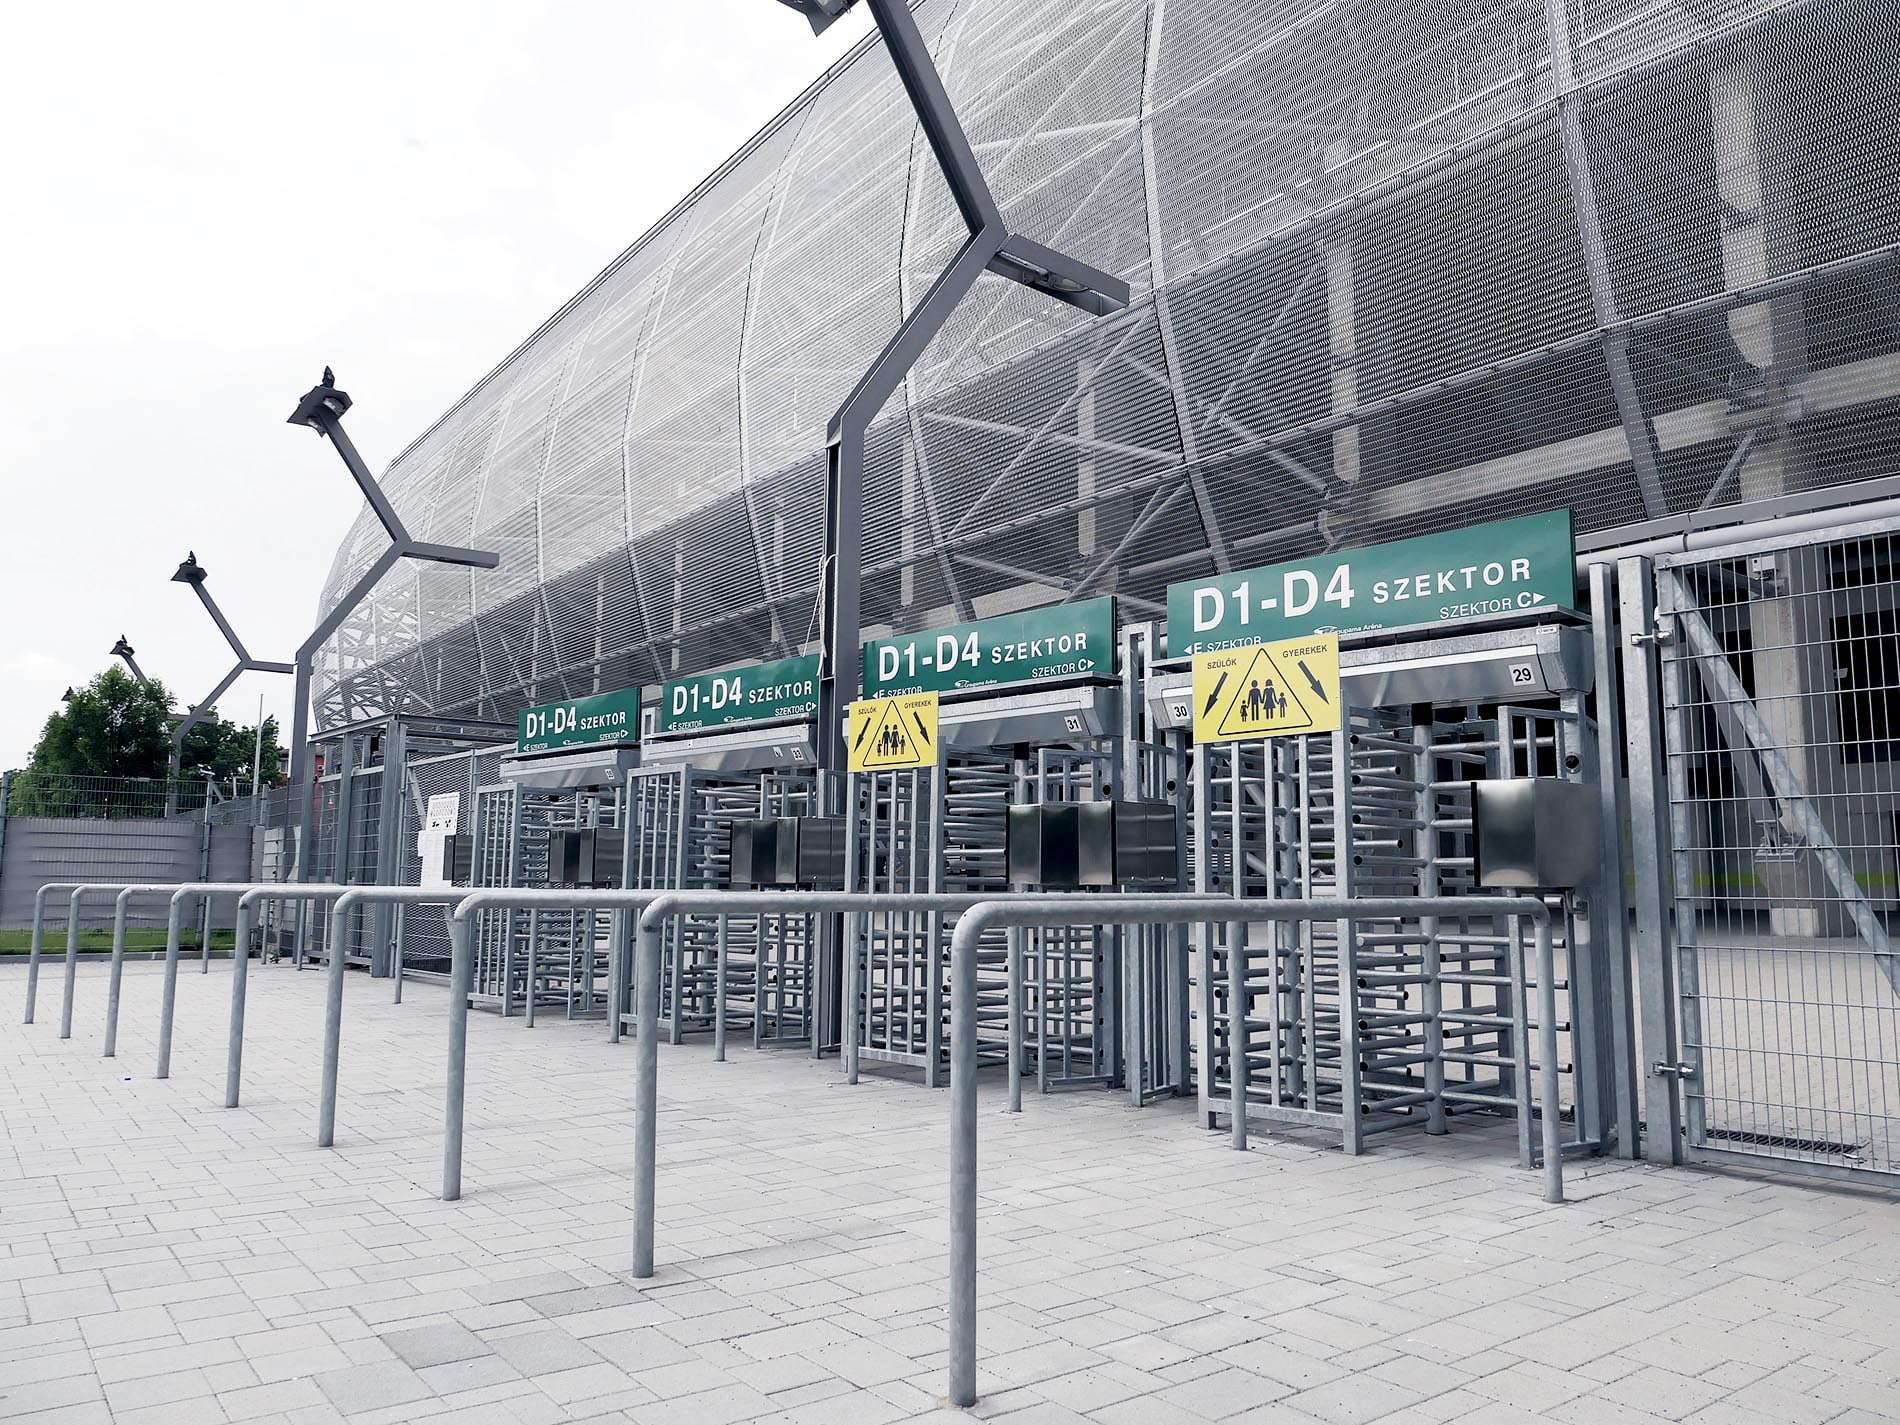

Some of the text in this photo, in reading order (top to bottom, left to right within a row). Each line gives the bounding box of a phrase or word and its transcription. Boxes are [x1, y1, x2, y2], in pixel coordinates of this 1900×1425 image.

[1193, 558, 1531, 633] D1-D4 SZEKTOR
[1440, 591, 1532, 619] SZEKTOR C
[879, 631, 1087, 682] D1-D4 SZEKTOR
[1282, 644, 1328, 658] GYEREKEK
[1031, 658, 1087, 678] SZEKTOR C
[1512, 667, 1532, 682] 29
[672, 676, 812, 716] D1-D4 SZEKTOR
[775, 704, 804, 716] SZEKTOR
[1174, 706, 1188, 718] 30
[526, 706, 626, 739] D1-D4 SZEKTOR
[678, 720, 702, 731] SZEKTOR
[1067, 719, 1079, 729] 31
